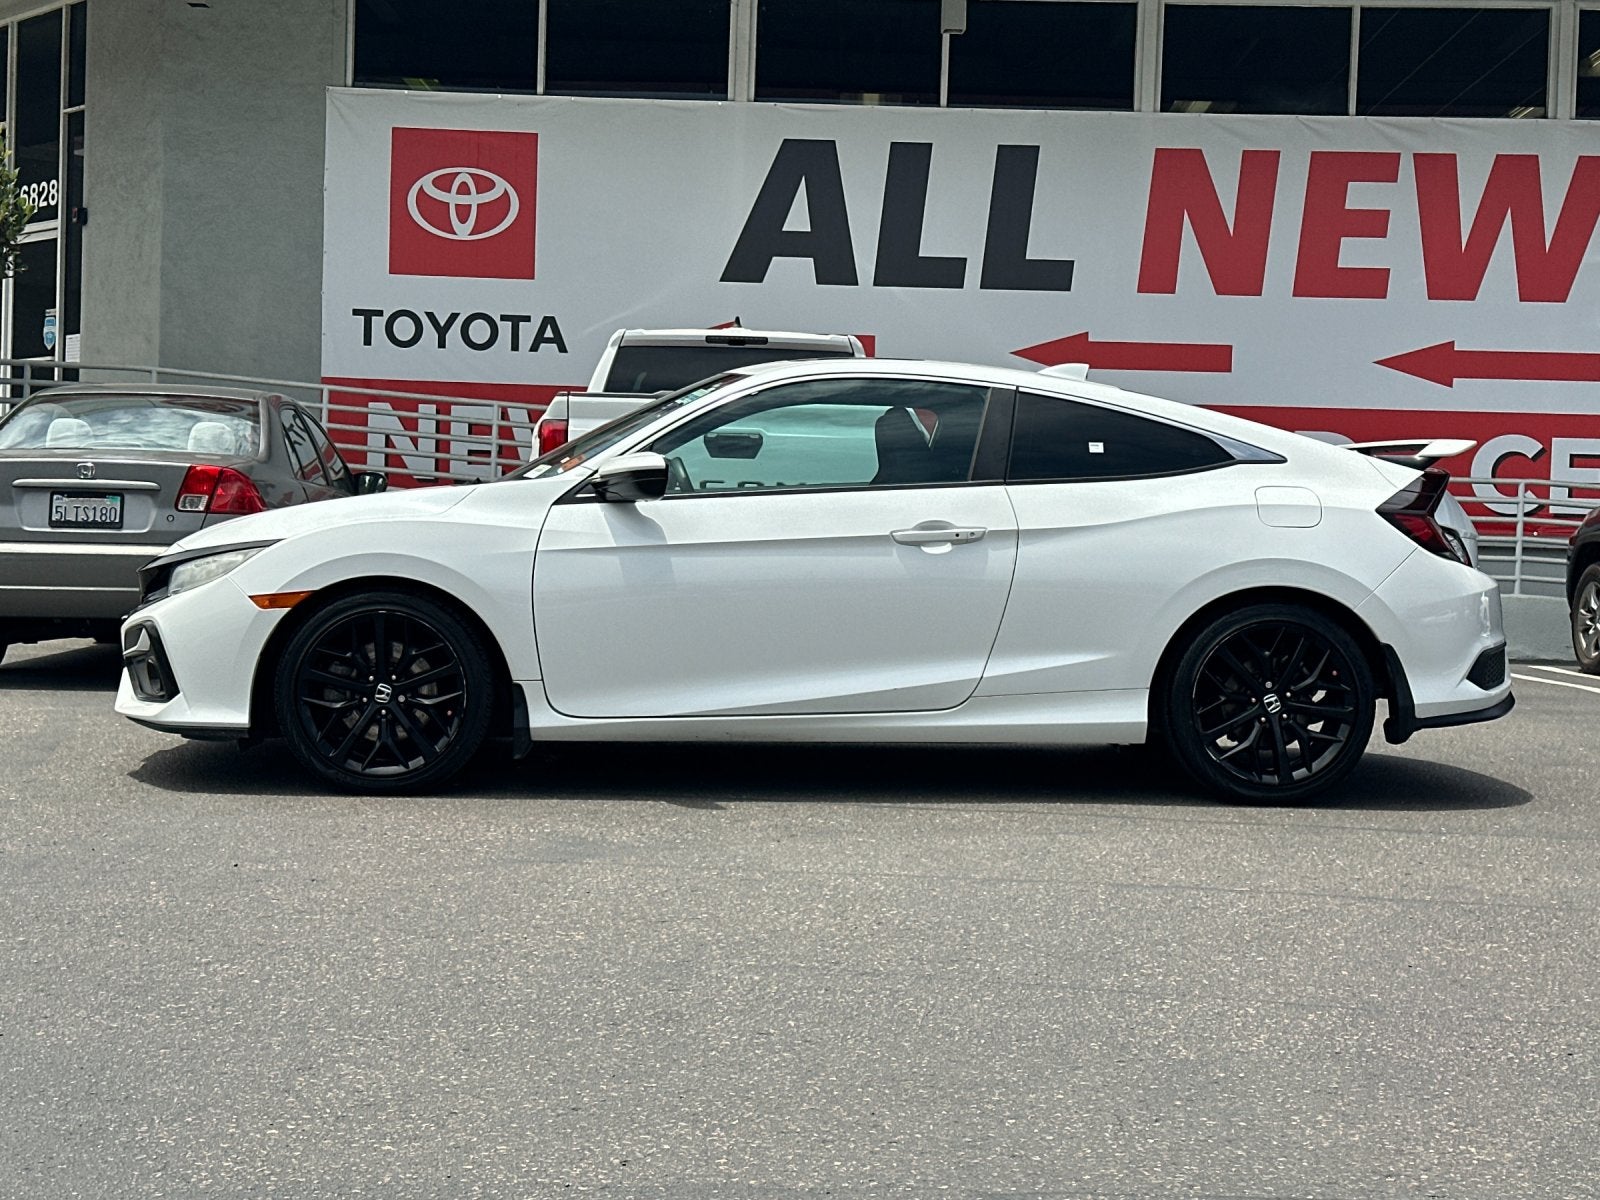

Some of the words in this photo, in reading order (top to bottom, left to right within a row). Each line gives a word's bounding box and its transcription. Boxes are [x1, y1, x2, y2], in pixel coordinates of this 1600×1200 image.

[20, 179, 58, 209] 6828
[719, 138, 1075, 292] ALL
[1136, 147, 1600, 303] NEW
[352, 308, 568, 354] TOYOTA
[54, 505, 118, 523] 5LTS180
